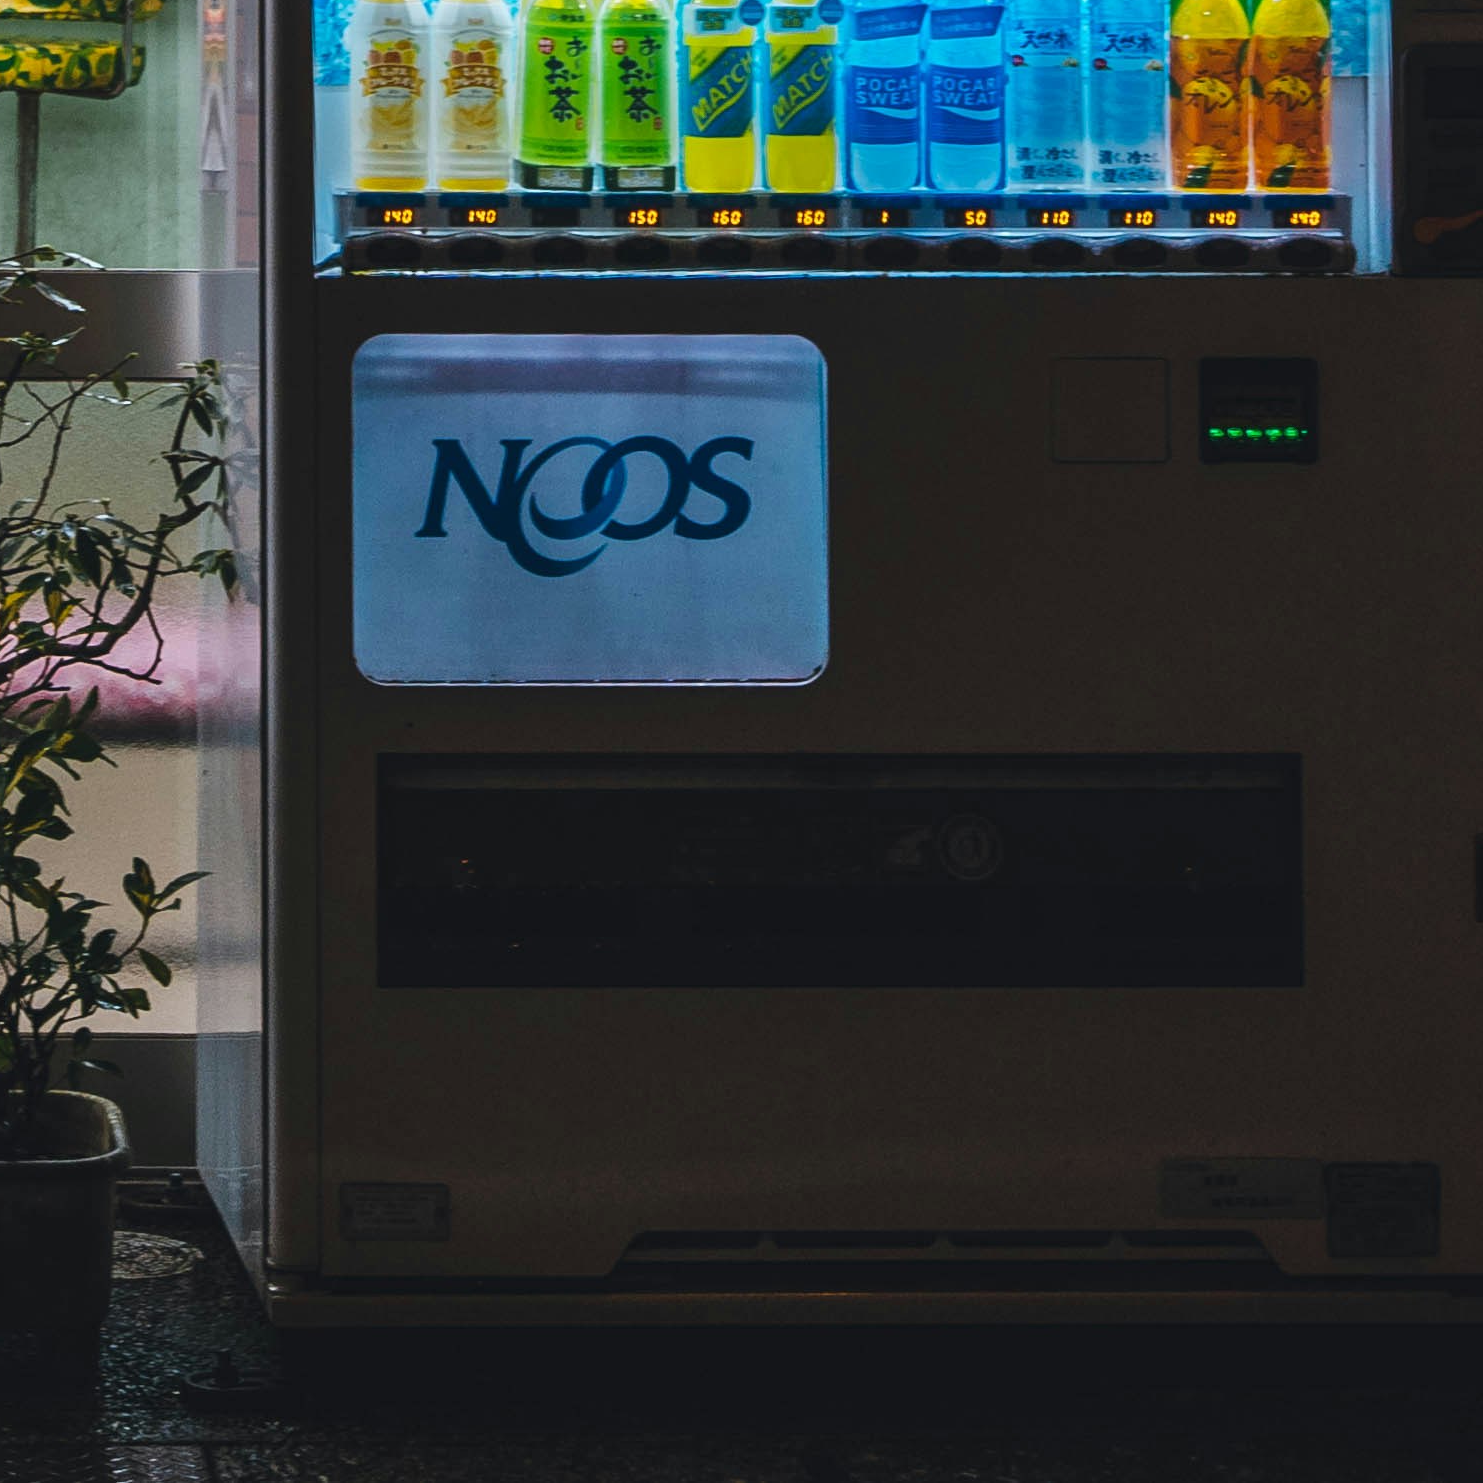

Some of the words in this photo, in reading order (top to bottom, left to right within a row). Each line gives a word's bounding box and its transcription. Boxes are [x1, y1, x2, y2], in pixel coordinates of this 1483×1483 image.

[691, 51, 752, 120] MATCH
[772, 51, 834, 120] MATCH
[384, 209, 413, 224] 140
[468, 209, 497, 224] 140
[629, 209, 658, 225] 150
[712, 209, 742, 225] 160
[796, 210, 825, 226] 160
[1042, 210, 1070, 225] 110
[1125, 211, 1153, 226] 110
[1208, 210, 1237, 226] 140
[1291, 211, 1321, 226] 140
